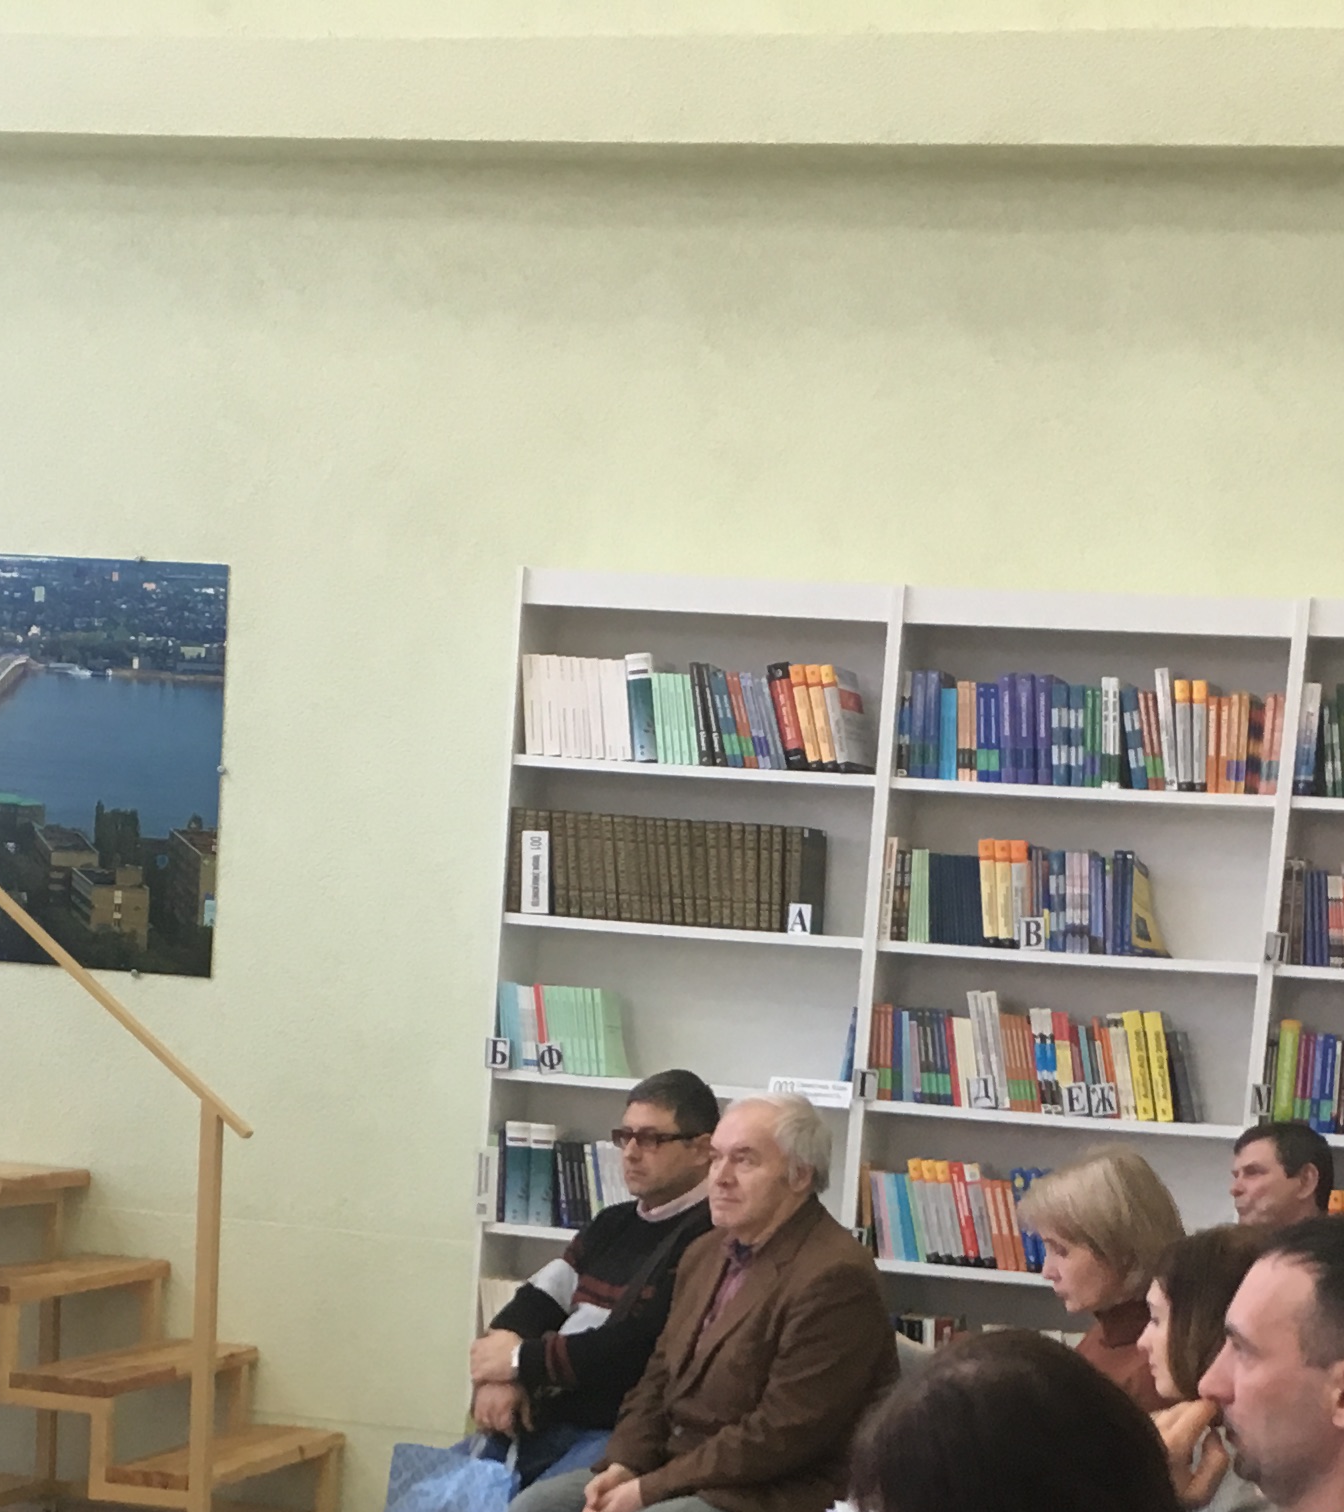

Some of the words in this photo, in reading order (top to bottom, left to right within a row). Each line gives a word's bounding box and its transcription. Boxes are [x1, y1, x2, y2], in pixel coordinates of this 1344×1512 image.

[789, 907, 809, 933] А
[1025, 921, 1042, 946] В
[490, 1041, 508, 1066] Б
[539, 1045, 564, 1071] Ф
[974, 1078, 993, 1106] Д
[1068, 1085, 1086, 1112] Е
[1090, 1085, 1116, 1113] Ж
